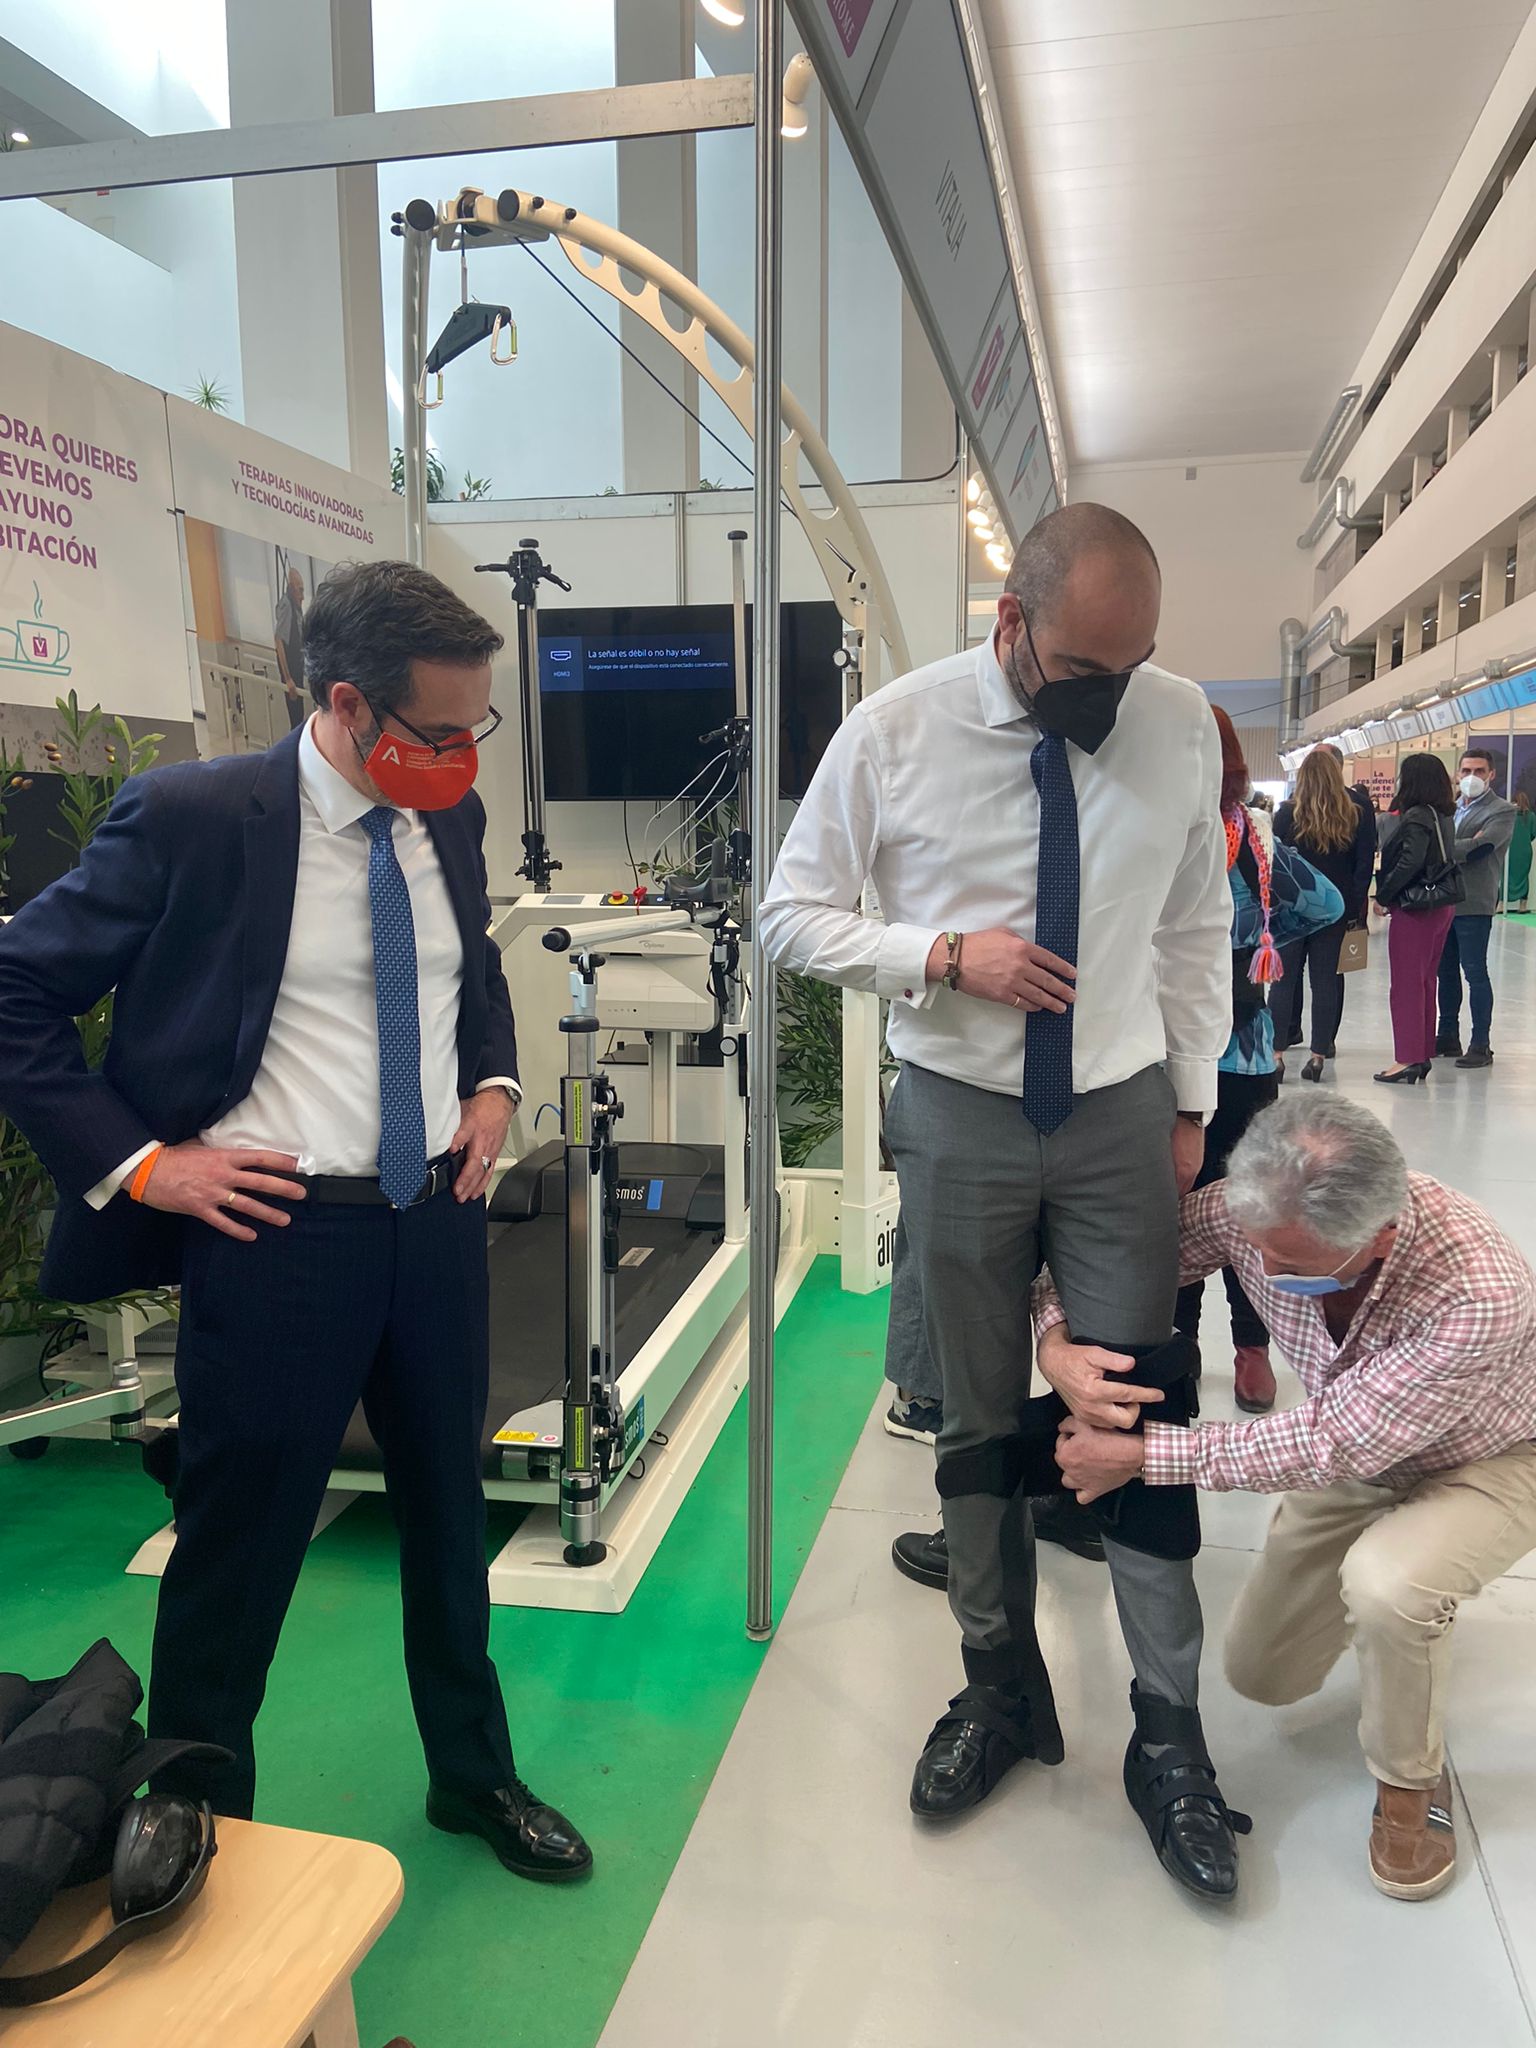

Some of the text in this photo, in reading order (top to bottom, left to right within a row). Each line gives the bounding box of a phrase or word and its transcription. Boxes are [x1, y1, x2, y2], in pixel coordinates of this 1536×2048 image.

[935, 159, 967, 262] VITALIA
[0, 450, 93, 500] EVEMOS
[52, 433, 138, 483] QUIERES
[231, 478, 374, 545] Y TECNOLOGÍAS AVANZADAS
[238, 460, 364, 522] TERAPIAS INNOVADORAS
[588, 650, 597, 658] La
[598, 649, 618, 658] señal
[628, 648, 647, 657] débil
[654, 649, 664, 657] no
[665, 648, 680, 658] hay
[680, 647, 701, 656] señal
[1373, 770, 1384, 778] La
